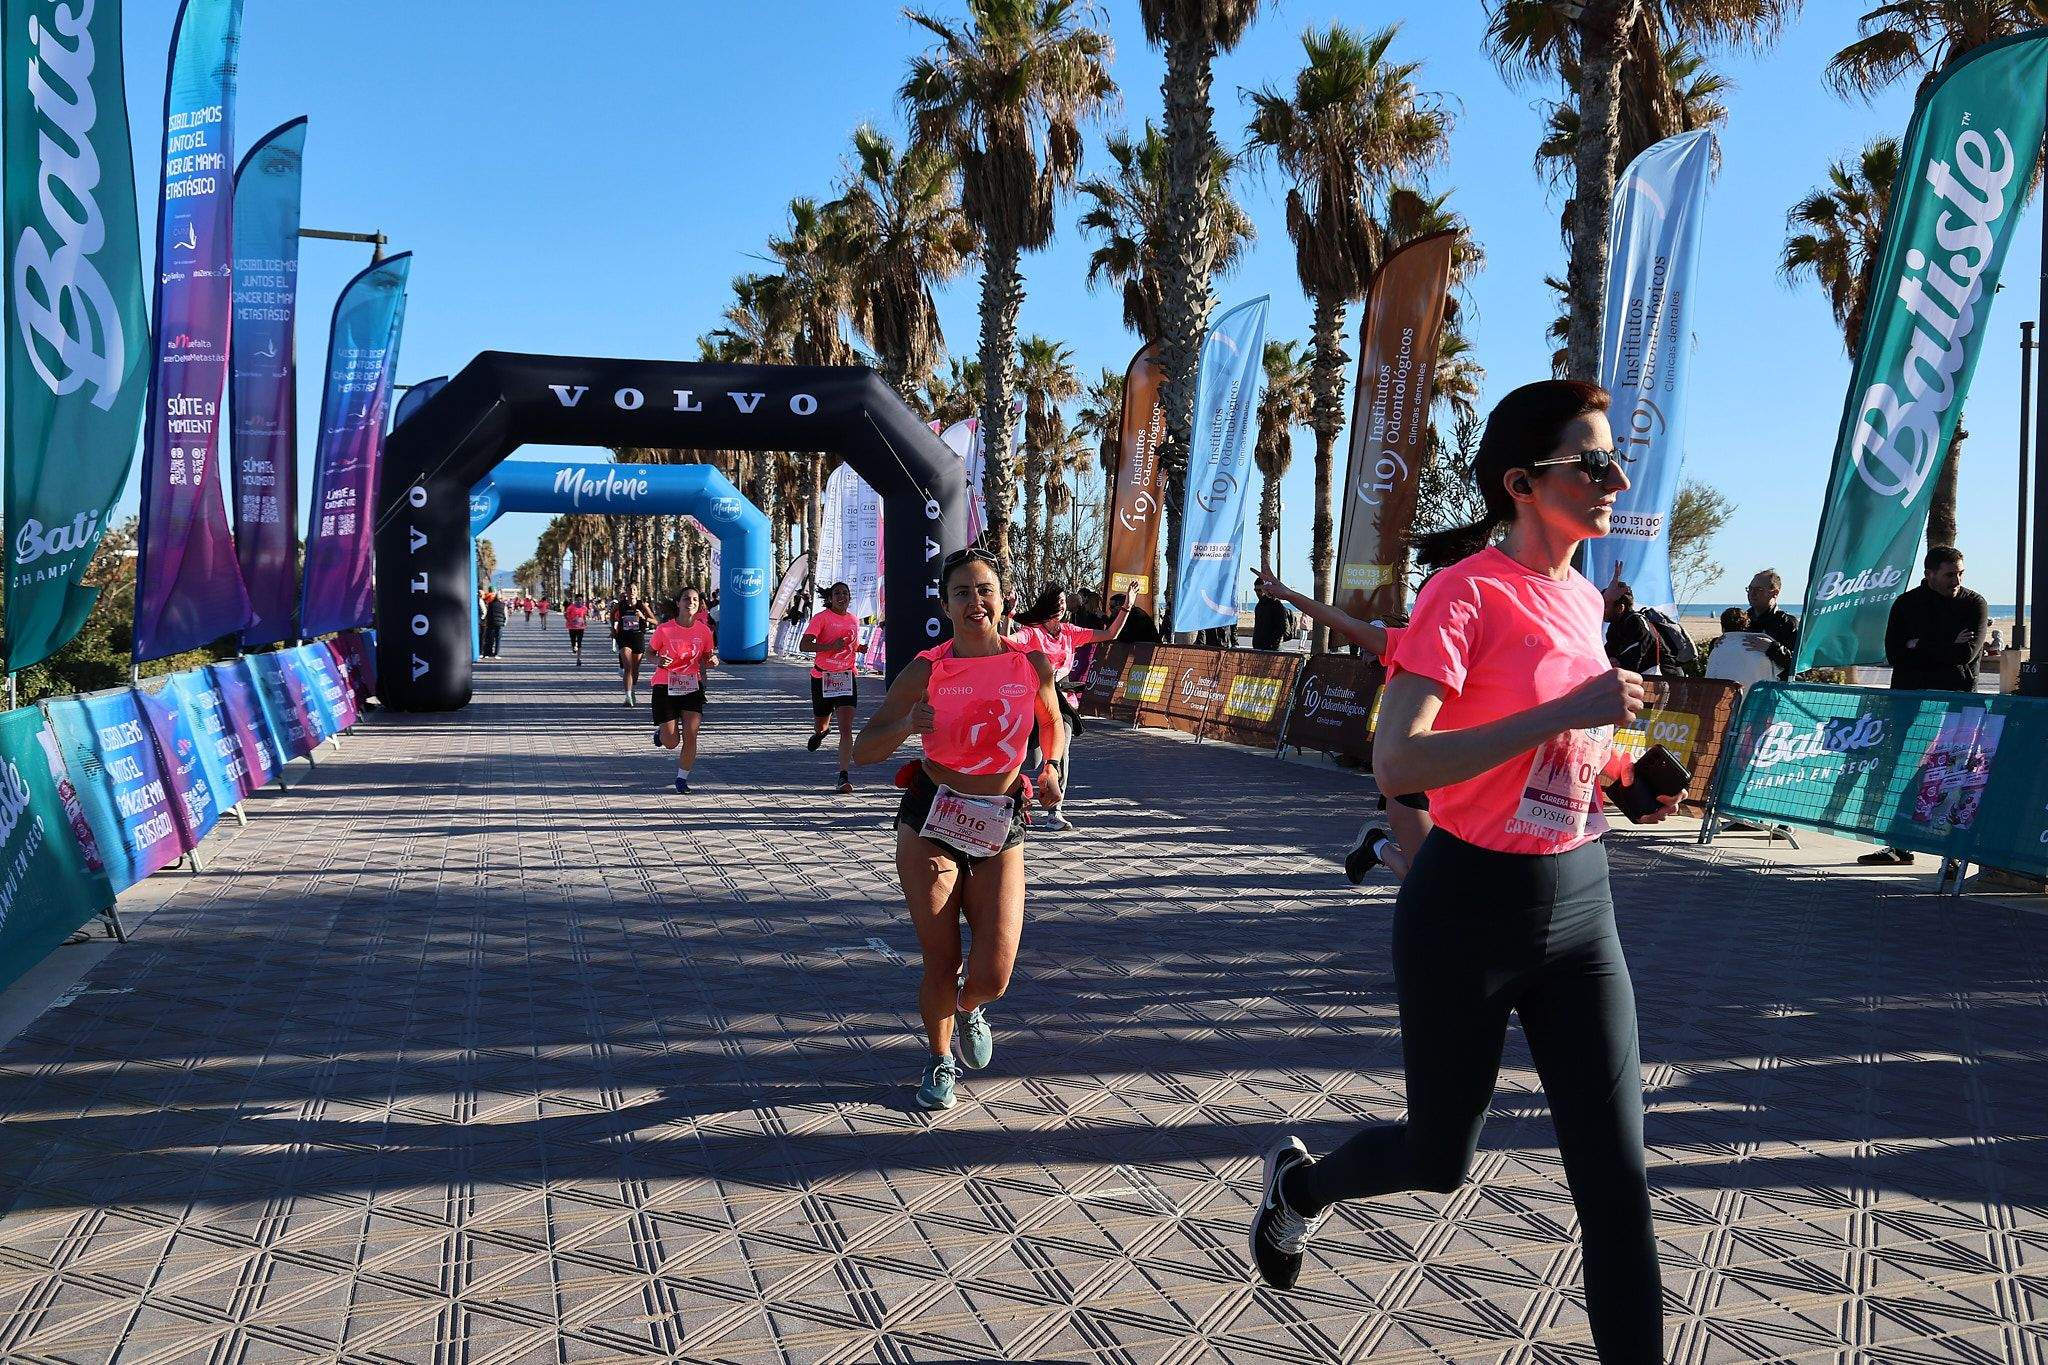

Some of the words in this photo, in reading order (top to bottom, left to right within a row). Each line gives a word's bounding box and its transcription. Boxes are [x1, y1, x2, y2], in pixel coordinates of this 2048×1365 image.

[166, 175, 216, 200] ETASTÁSICO
[238, 306, 291, 321] METASTÁSIC
[1643, 255, 1666, 391] Odontológicos
[1668, 290, 1681, 344] dentales
[1852, 127, 2014, 509] Batiste
[1621, 297, 1644, 389] Institutos
[548, 384, 819, 416] VOLVO
[1369, 364, 1391, 443] Institutos
[1386, 327, 1414, 444] Odontológicos
[1408, 406, 1420, 446] Clínicas
[1414, 362, 1427, 405] dentales
[1208, 408, 1223, 466] Institutos
[1220, 380, 1240, 467] Odontológicos
[1131, 429, 1146, 485] Institutos
[553, 467, 648, 508] Marlene
[15, 509, 99, 565] Bati
[1629, 516, 1643, 526] 131
[409, 485, 430, 682] VOLVO
[732, 574, 763, 588] Marlene
[925, 499, 941, 638] OLVO
[1815, 565, 1902, 601] Batiste
[1812, 599, 1851, 616] CHAMPÚ
[938, 686, 973, 696] OYSHO
[1325, 684, 1356, 699] Institutos
[1653, 721, 1690, 744] 002
[1748, 713, 1886, 768] Batiste
[1810, 767, 1832, 781] EN
[1838, 758, 1879, 776] SECO
[1531, 806, 1575, 826] OYSHO
[1540, 793, 1570, 808] CARRERA
[956, 813, 987, 832] 016
